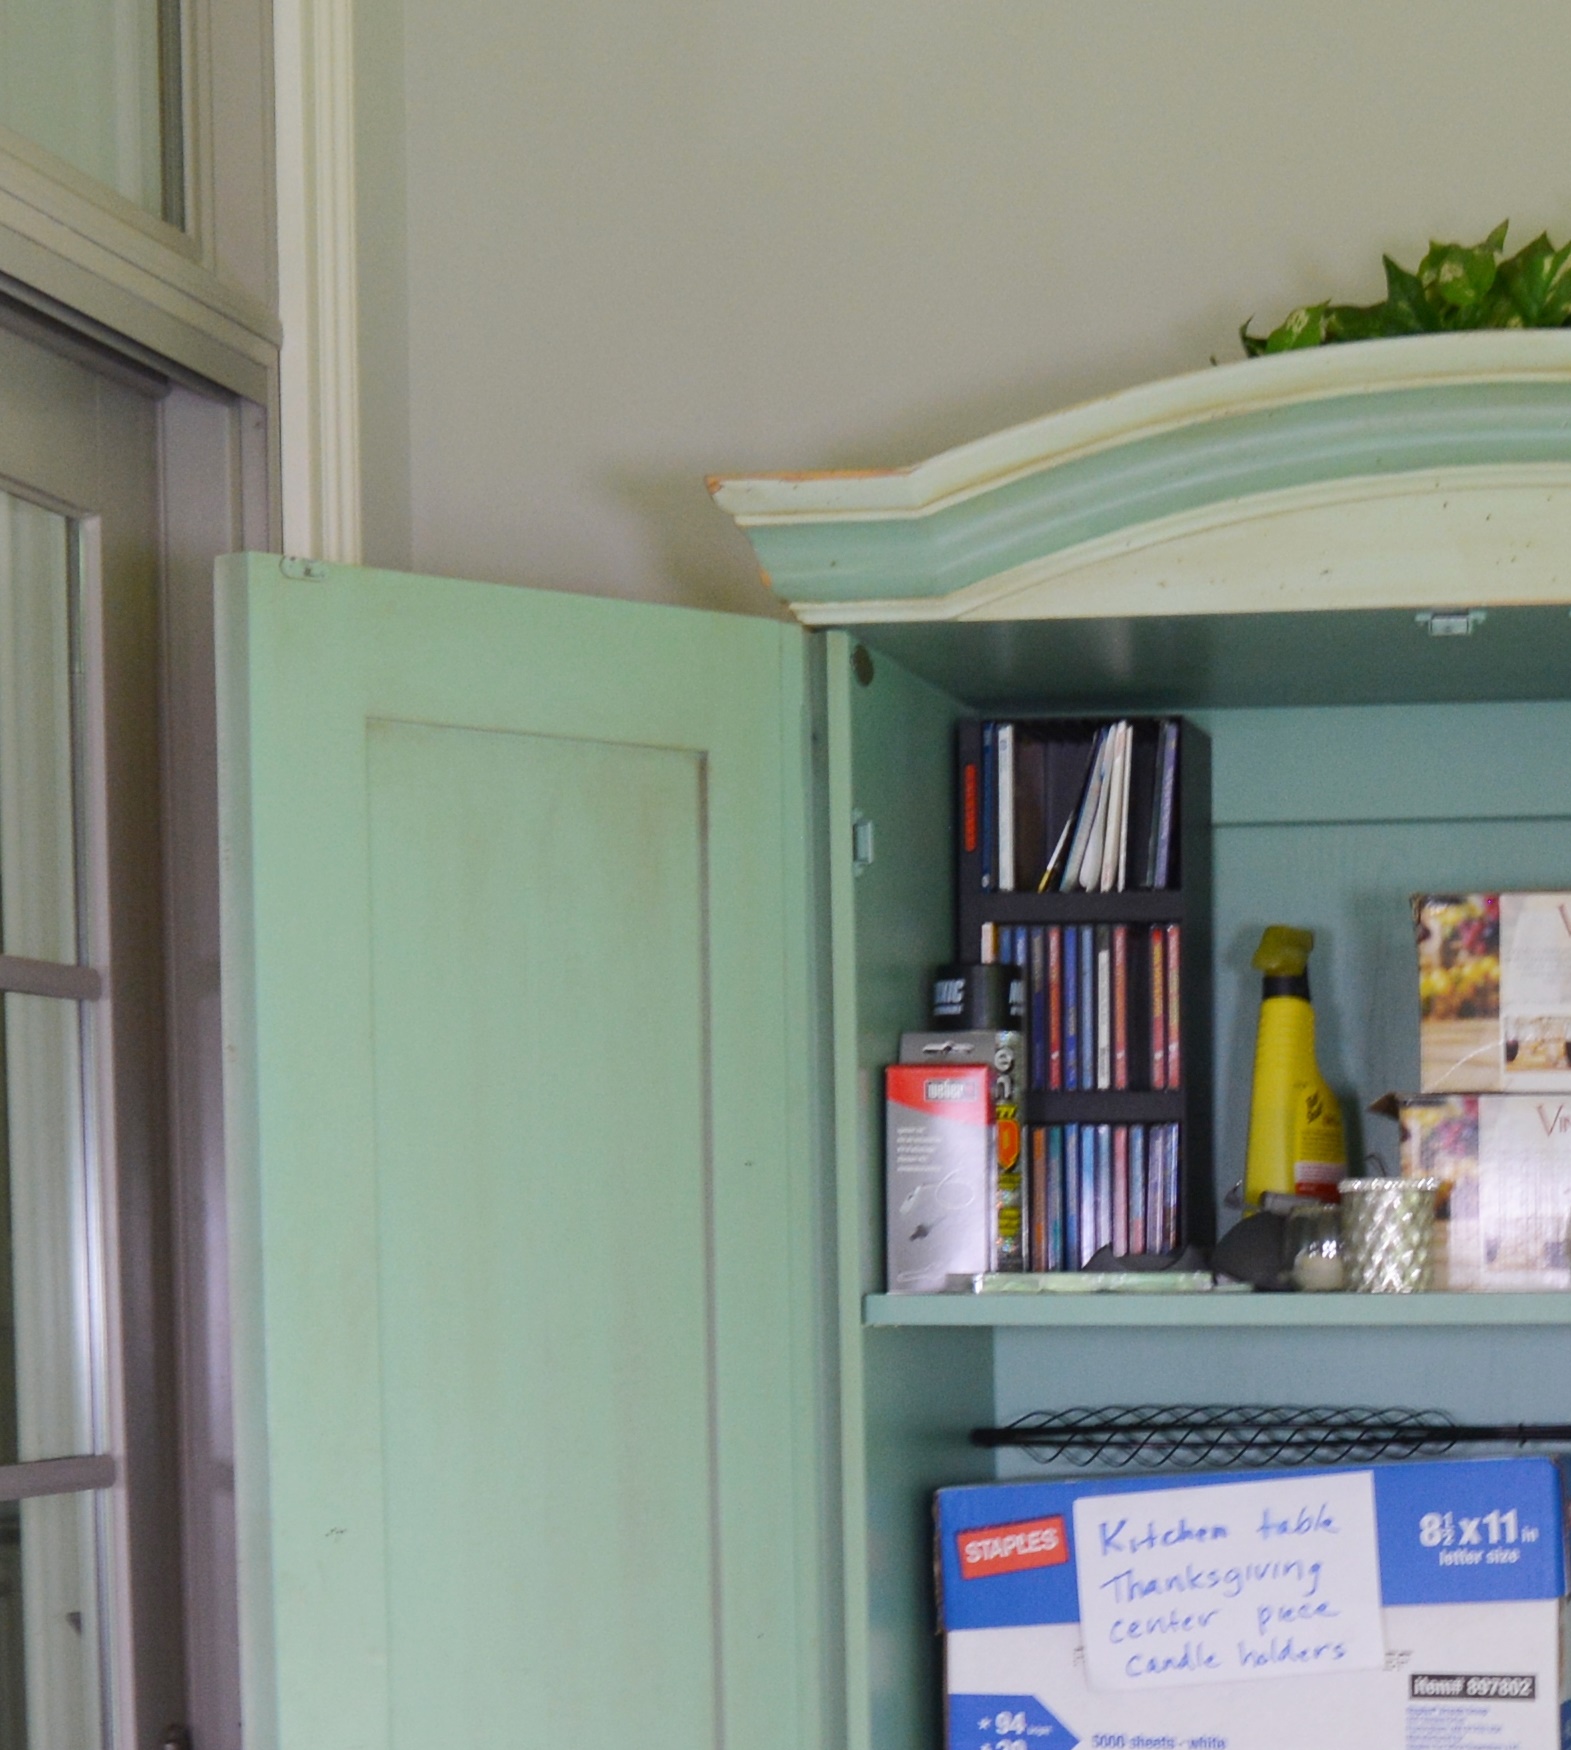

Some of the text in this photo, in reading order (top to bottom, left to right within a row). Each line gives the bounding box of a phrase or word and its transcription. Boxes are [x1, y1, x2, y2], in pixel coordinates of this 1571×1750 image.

[965, 1527, 1059, 1564] STAPLES
[1098, 1502, 1341, 1556] Kitchen table
[1439, 1546, 1521, 1566] letter size
[1099, 1560, 1323, 1604] Thanksgiving
[1256, 1600, 1342, 1636] piece
[1237, 1637, 1346, 1667] holders
[995, 1711, 1027, 1735] 94
[1129, 1735, 1176, 1750] sheets
